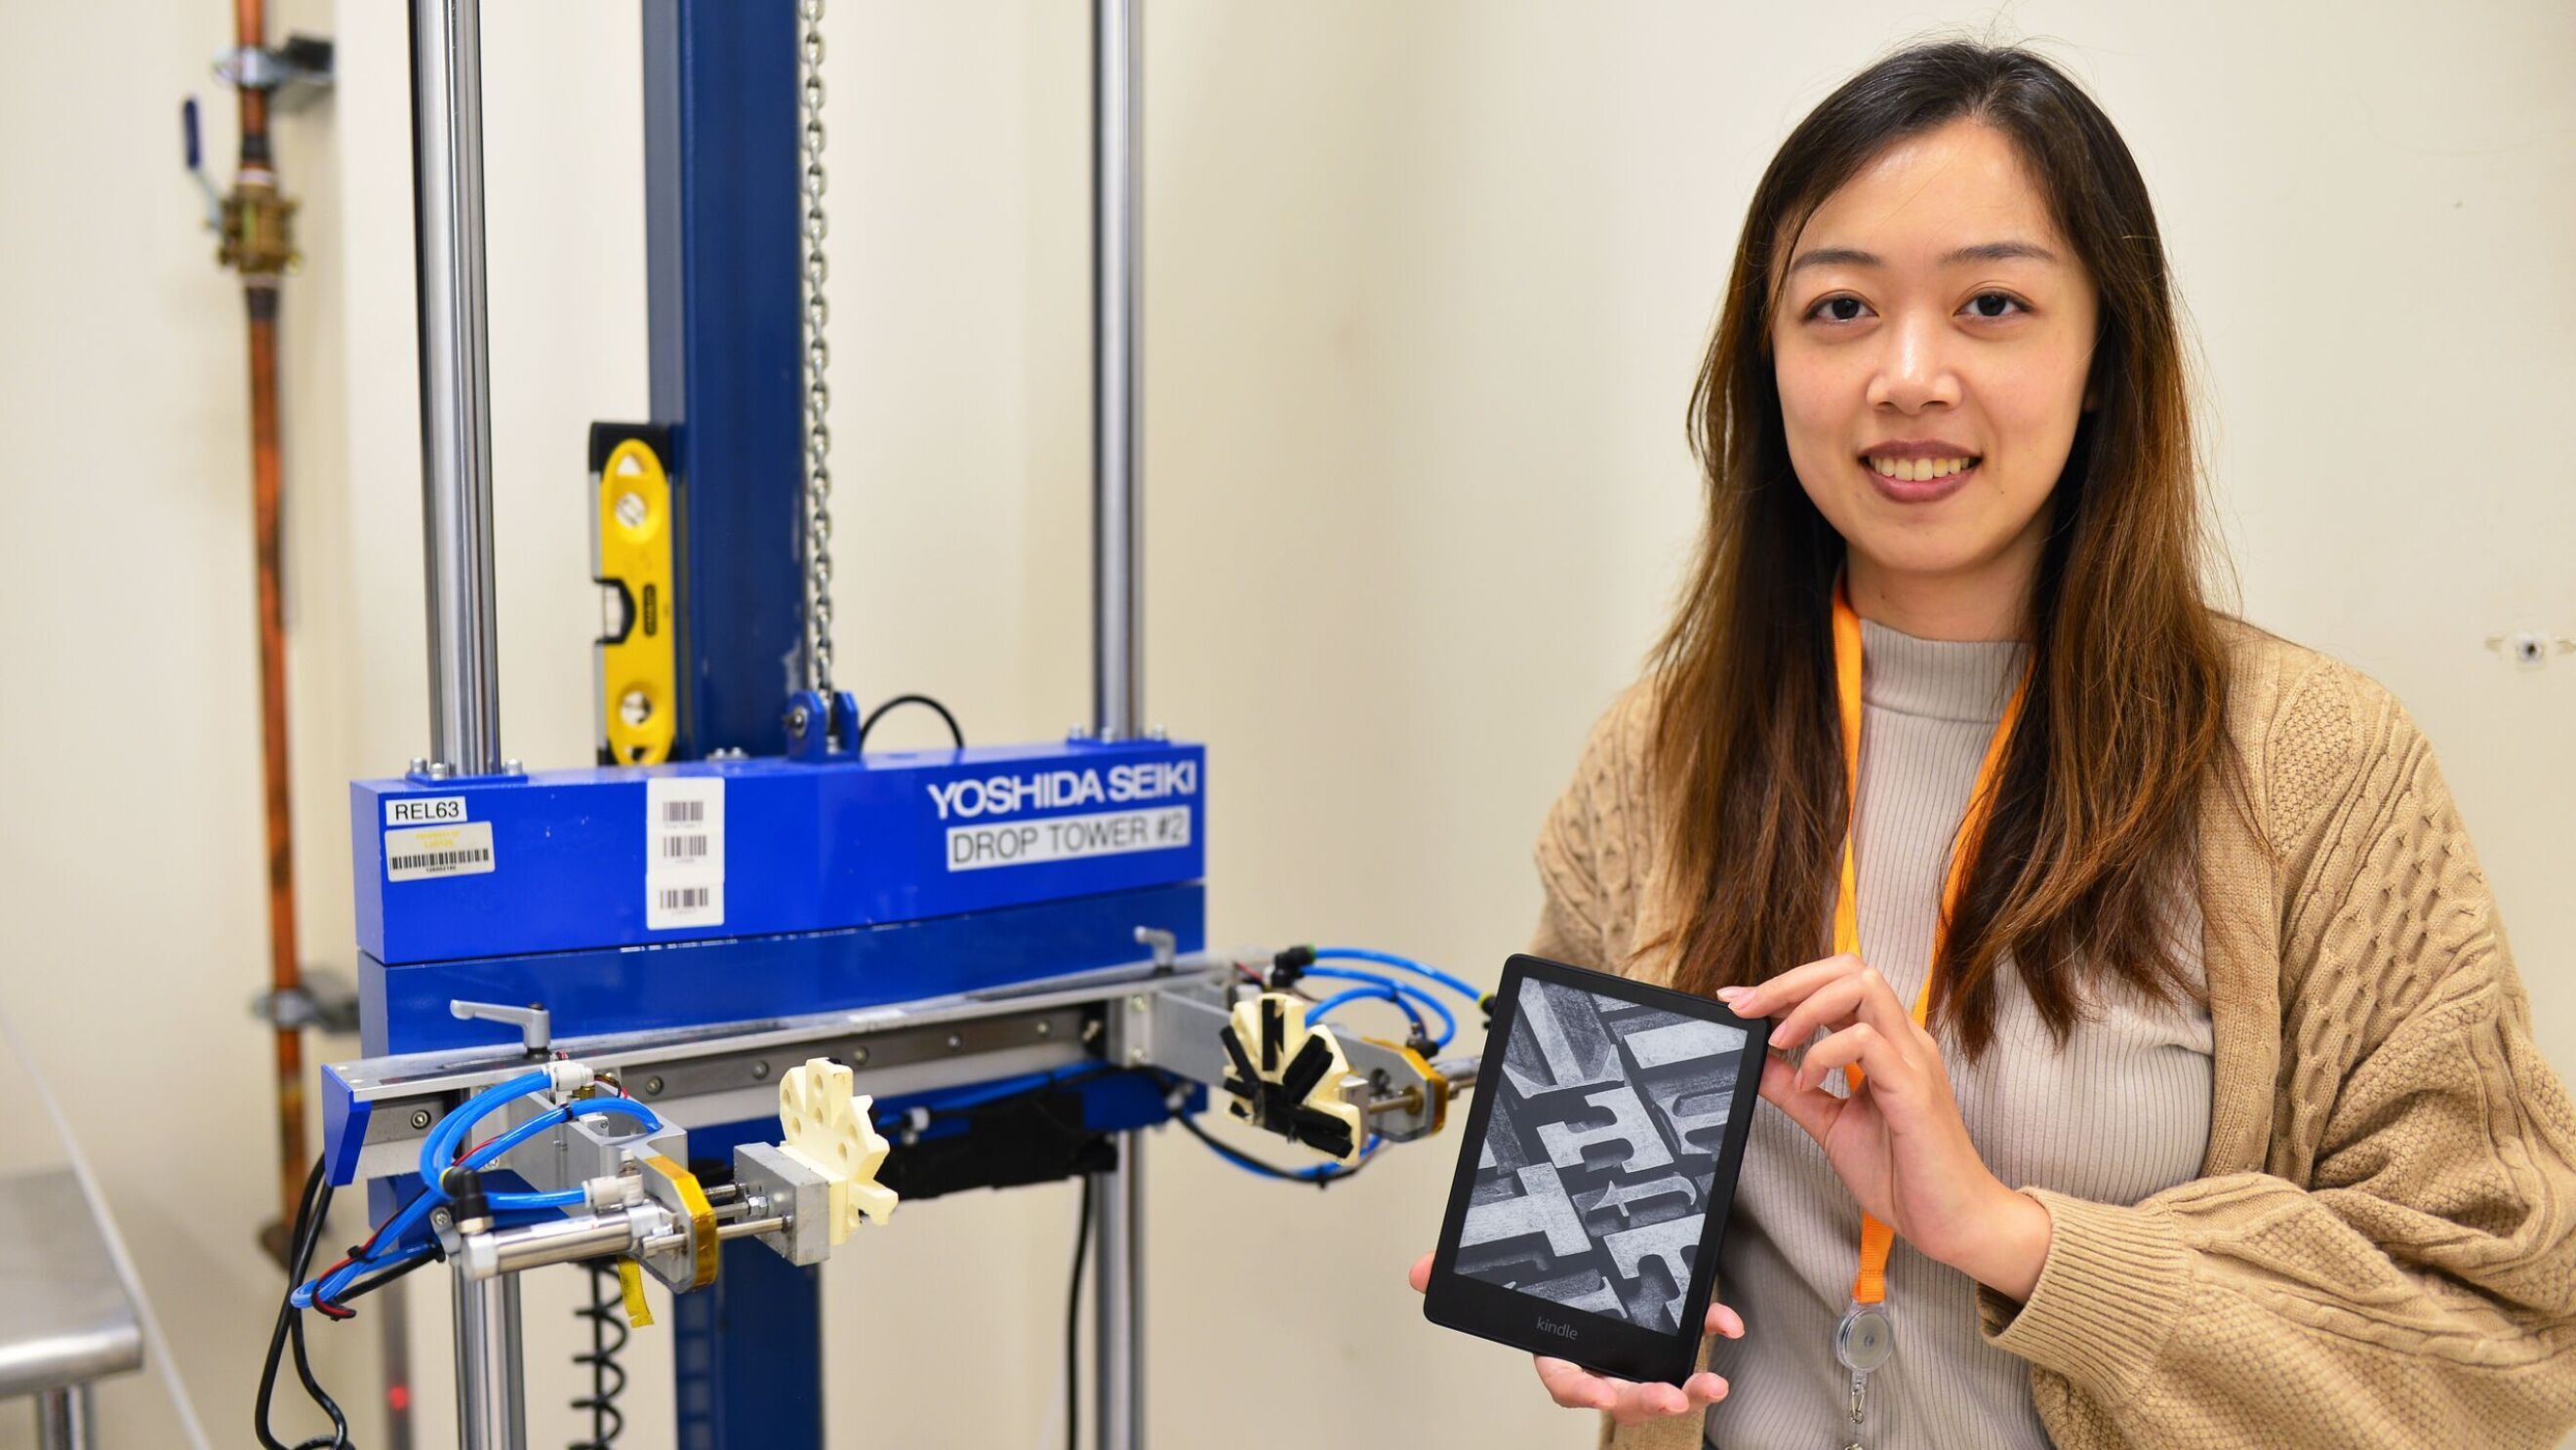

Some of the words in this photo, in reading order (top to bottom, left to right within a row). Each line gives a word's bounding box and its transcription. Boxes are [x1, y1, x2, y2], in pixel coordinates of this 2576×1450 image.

[927, 768, 1107, 820] YOSHIDA
[1107, 760, 1197, 802] SEIKI
[394, 800, 460, 821] REL63
[952, 827, 1038, 864] DROP
[1047, 815, 1148, 852] TOWER
[1155, 811, 1187, 841] #2
[1537, 1316, 1578, 1340] kindle
